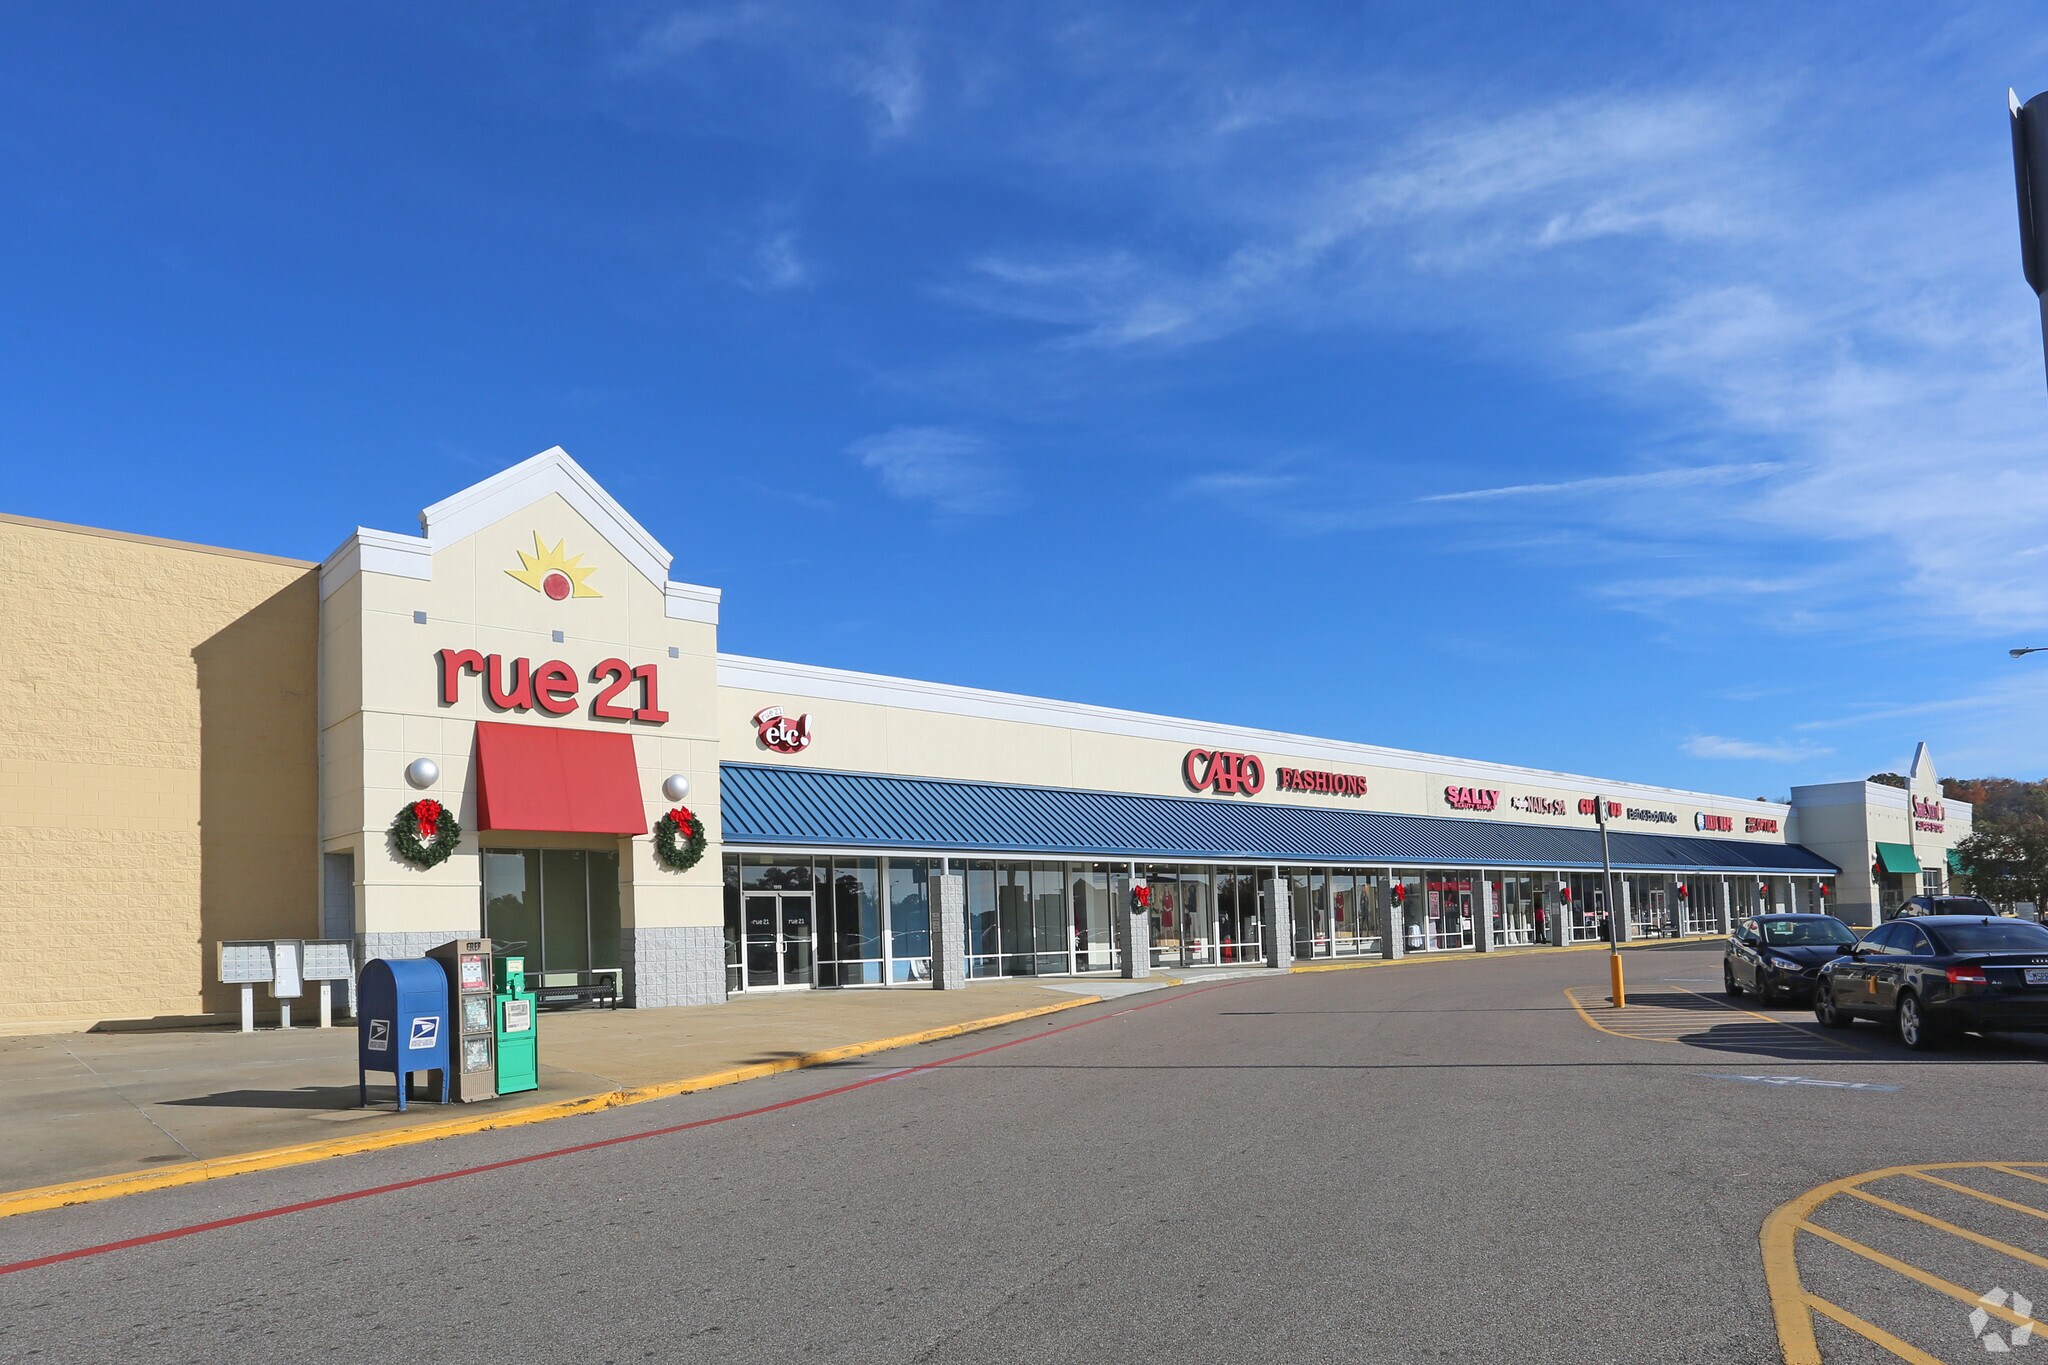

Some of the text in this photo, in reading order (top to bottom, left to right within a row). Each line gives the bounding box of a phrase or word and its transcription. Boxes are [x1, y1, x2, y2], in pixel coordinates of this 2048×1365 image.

[438, 648, 670, 724] rue 21
[1185, 748, 1266, 796] CATO
[1278, 767, 1368, 796] FASHIONS
[1446, 785, 1501, 806] SALLY
[1454, 802, 1476, 810] BEAUTY
[1527, 796, 1548, 813] NAILS
